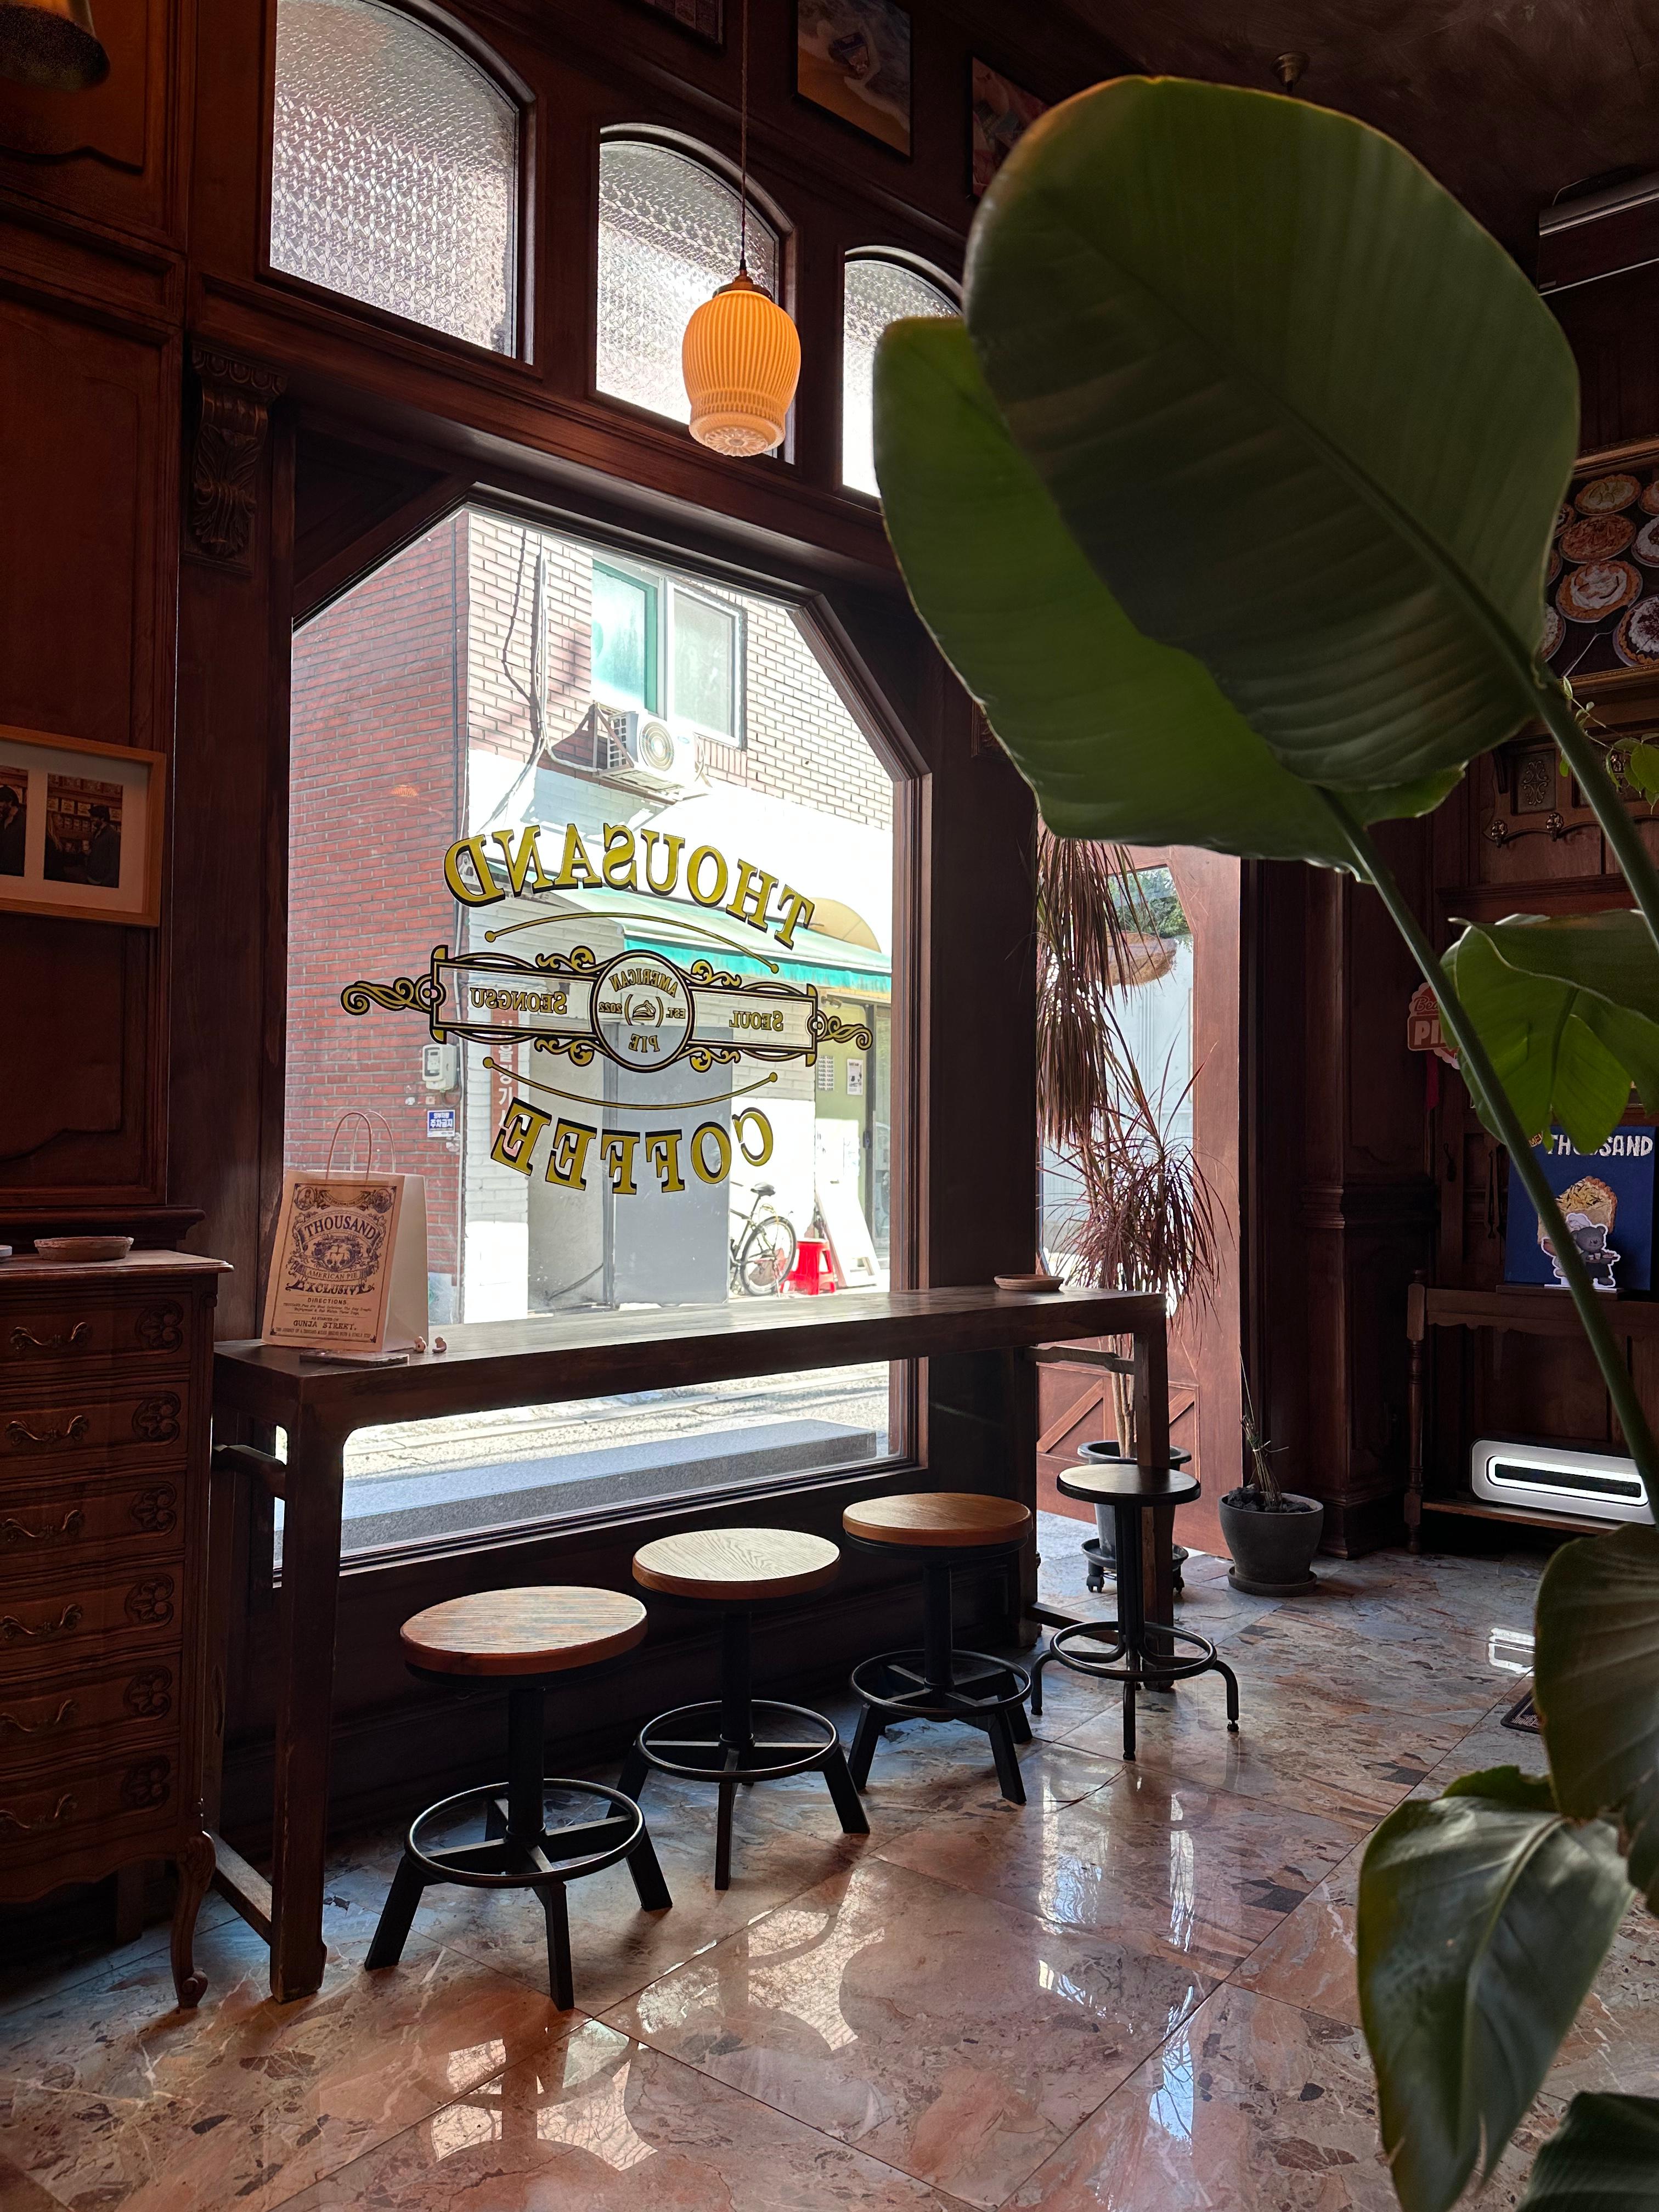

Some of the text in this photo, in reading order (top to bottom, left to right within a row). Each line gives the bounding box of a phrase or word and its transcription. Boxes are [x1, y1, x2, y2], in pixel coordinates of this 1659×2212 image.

[1414, 1020, 1446, 1045] PI
[430, 1119, 453, 1127] 주차금지
[304, 1216, 377, 1240] THOUSAND
[307, 1270, 344, 1279] AMERICAN
[285, 1278, 375, 1295] EXCLUSIVE
